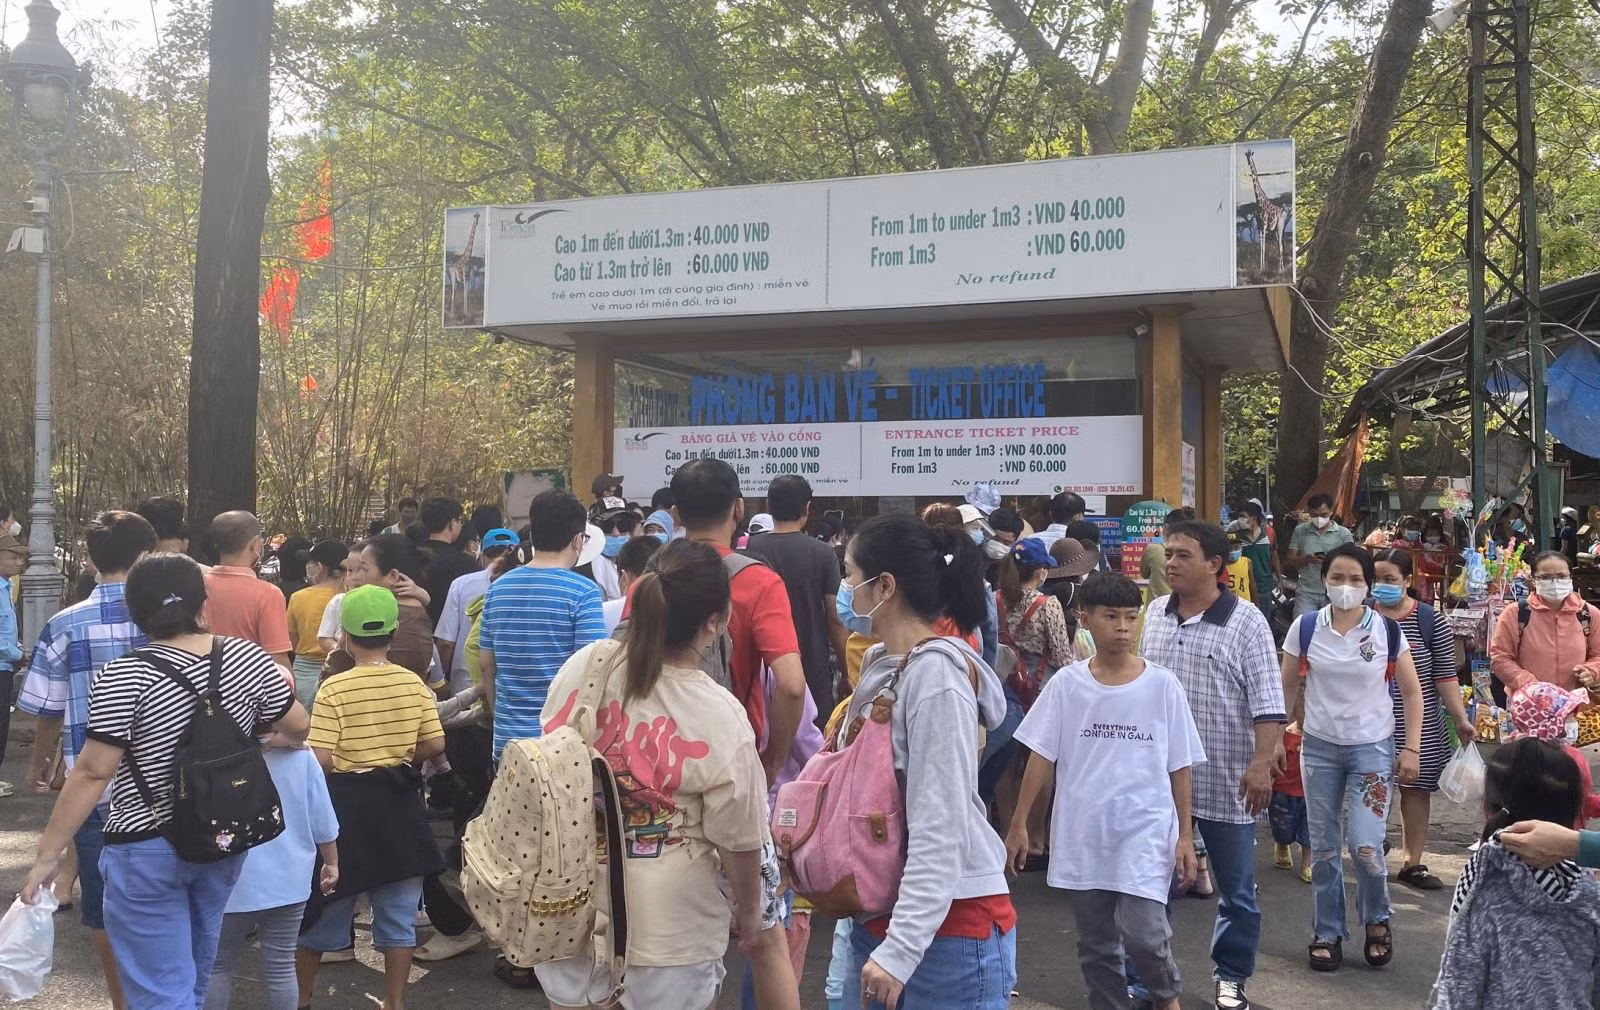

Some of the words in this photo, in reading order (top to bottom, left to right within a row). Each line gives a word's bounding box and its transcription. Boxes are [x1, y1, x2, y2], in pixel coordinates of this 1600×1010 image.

[871, 215, 904, 237] From
[908, 213, 928, 234] 1m
[931, 212, 945, 233] to
[949, 208, 987, 232] under
[992, 205, 1021, 228] 1m3
[1070, 196, 1126, 221] 40.000
[555, 234, 577, 255] Cao
[581, 233, 599, 253] 1m
[602, 228, 625, 252] đến
[742, 221, 770, 243] VNĐ
[870, 246, 904, 268] From
[908, 243, 937, 265] 1m3
[1070, 228, 1126, 253] 60.000
[554, 262, 576, 283] Cao
[579, 261, 594, 281] từ
[596, 259, 627, 281] 1.3m
[630, 255, 650, 278] trở
[653, 255, 672, 277] lên
[742, 251, 770, 272] VNĐ
[956, 273, 983, 285] No
[989, 267, 1057, 285] refund
[551, 290, 566, 300] Trẻ
[569, 291, 586, 299] em
[588, 290, 610, 298] cao
[612, 287, 636, 298] dưới
[640, 286, 656, 296] 1m
[674, 283, 704, 296] cùng
[705, 282, 724, 295] gia
[764, 278, 793, 289] miễn
[608, 302, 633, 311] mua
[654, 297, 679, 309] miễn
[705, 296, 721, 307] trả
[845, 357, 878, 421] VÉ
[885, 388, 898, 399] -
[908, 365, 975, 419] TICKET
[980, 363, 1046, 418] OFFICE
[681, 431, 712, 444] BẢNG
[716, 431, 738, 443] GIÁ
[740, 430, 757, 443] VÉ
[760, 431, 785, 443] VÀO
[788, 427, 822, 442] CỔNG
[884, 427, 965, 440] ENTRANCE
[969, 427, 1026, 438] TICKET
[1031, 425, 1080, 437] PRICE
[665, 449, 682, 461] Cao
[684, 449, 698, 460] 1m
[800, 446, 820, 458] VNĐ
[891, 446, 915, 458] From
[918, 446, 931, 457] 1m
[934, 446, 944, 457] to
[946, 445, 972, 457] under
[975, 444, 996, 456] 1m3
[1029, 443, 1067, 456] 40.000
[665, 464, 679, 476] Ca
[800, 462, 820, 474] VNĐ
[891, 462, 915, 474] From
[917, 462, 938, 474] 1m3
[1029, 460, 1067, 473] 60.000
[974, 478, 1020, 487] refund
[1080, 729, 1115, 739] CONFIDE
[1117, 731, 1126, 739] IN
[1128, 732, 1154, 741] GALA
[1093, 723, 1137, 732] EVERYTHING
